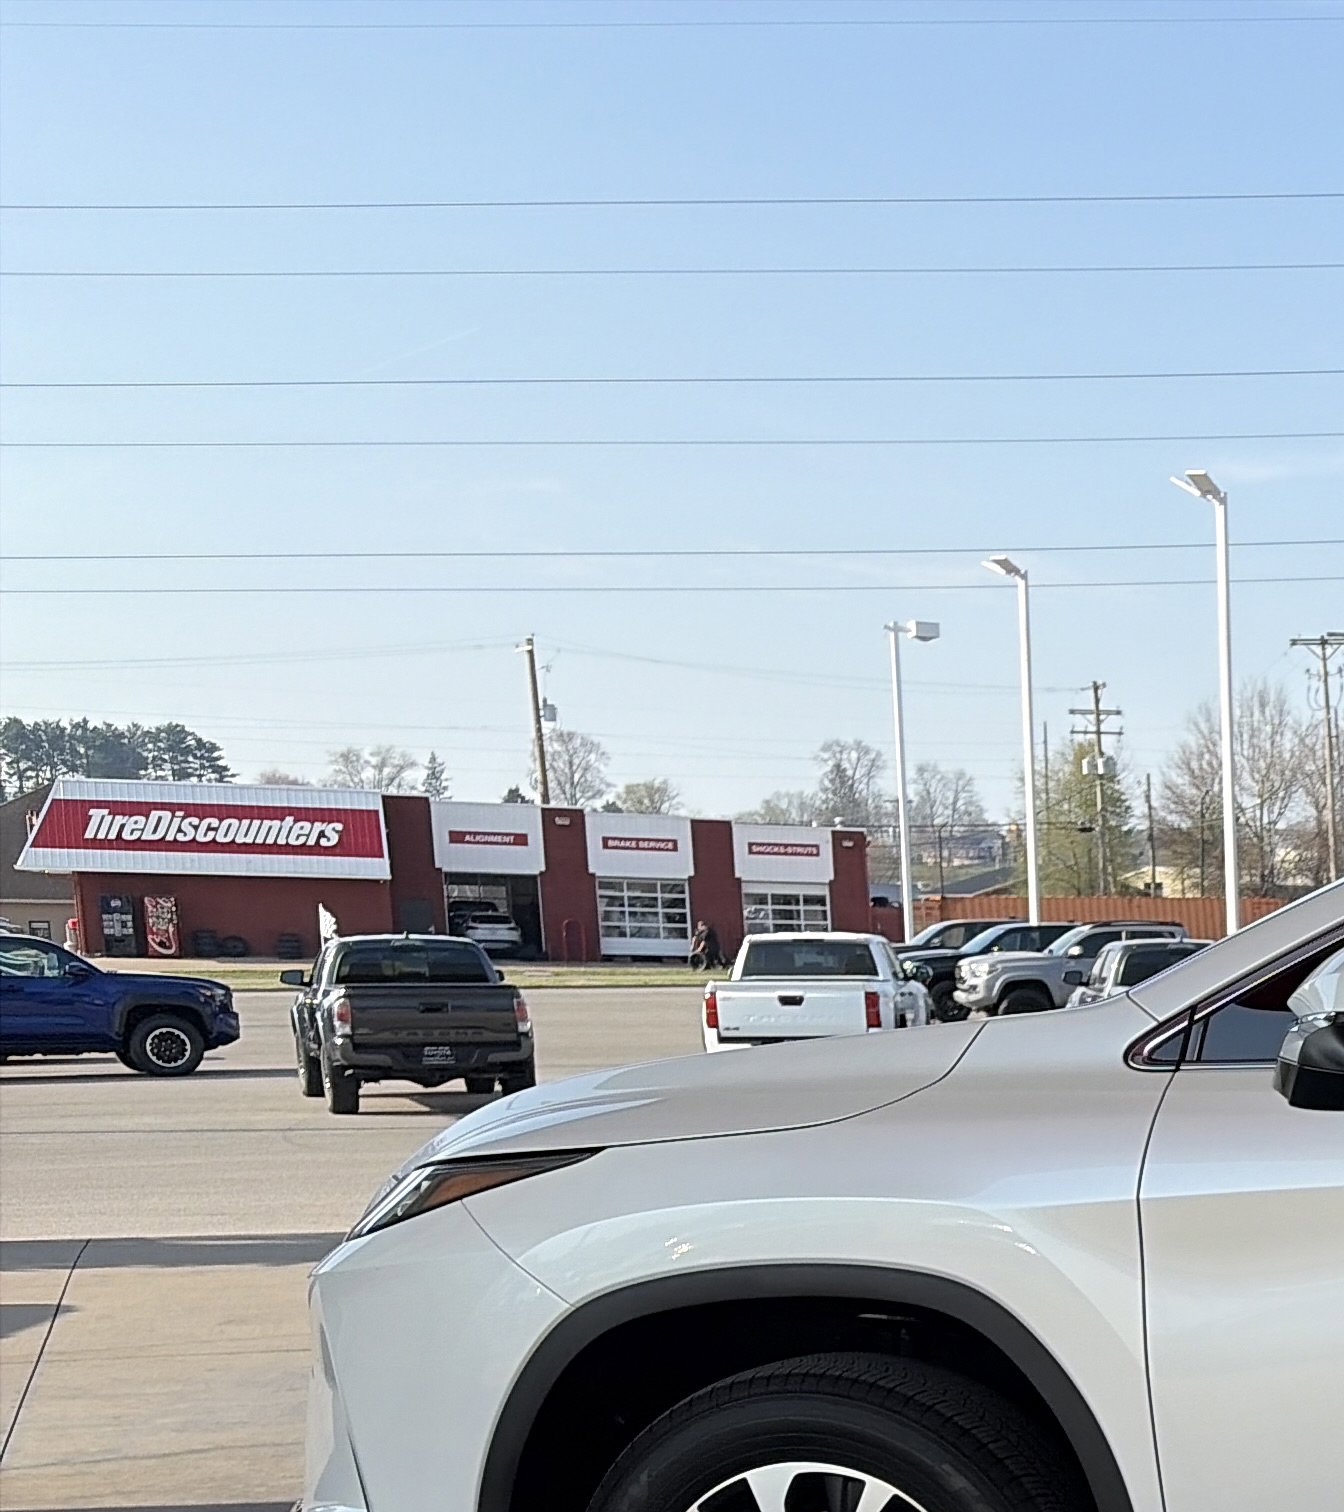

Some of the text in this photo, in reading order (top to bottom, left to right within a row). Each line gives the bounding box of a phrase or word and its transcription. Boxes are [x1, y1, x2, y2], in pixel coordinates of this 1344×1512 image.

[84, 808, 343, 847] TireDiscounters
[464, 834, 515, 844] ALIGNMENT
[607, 839, 675, 850] BRAKE SERVICE
